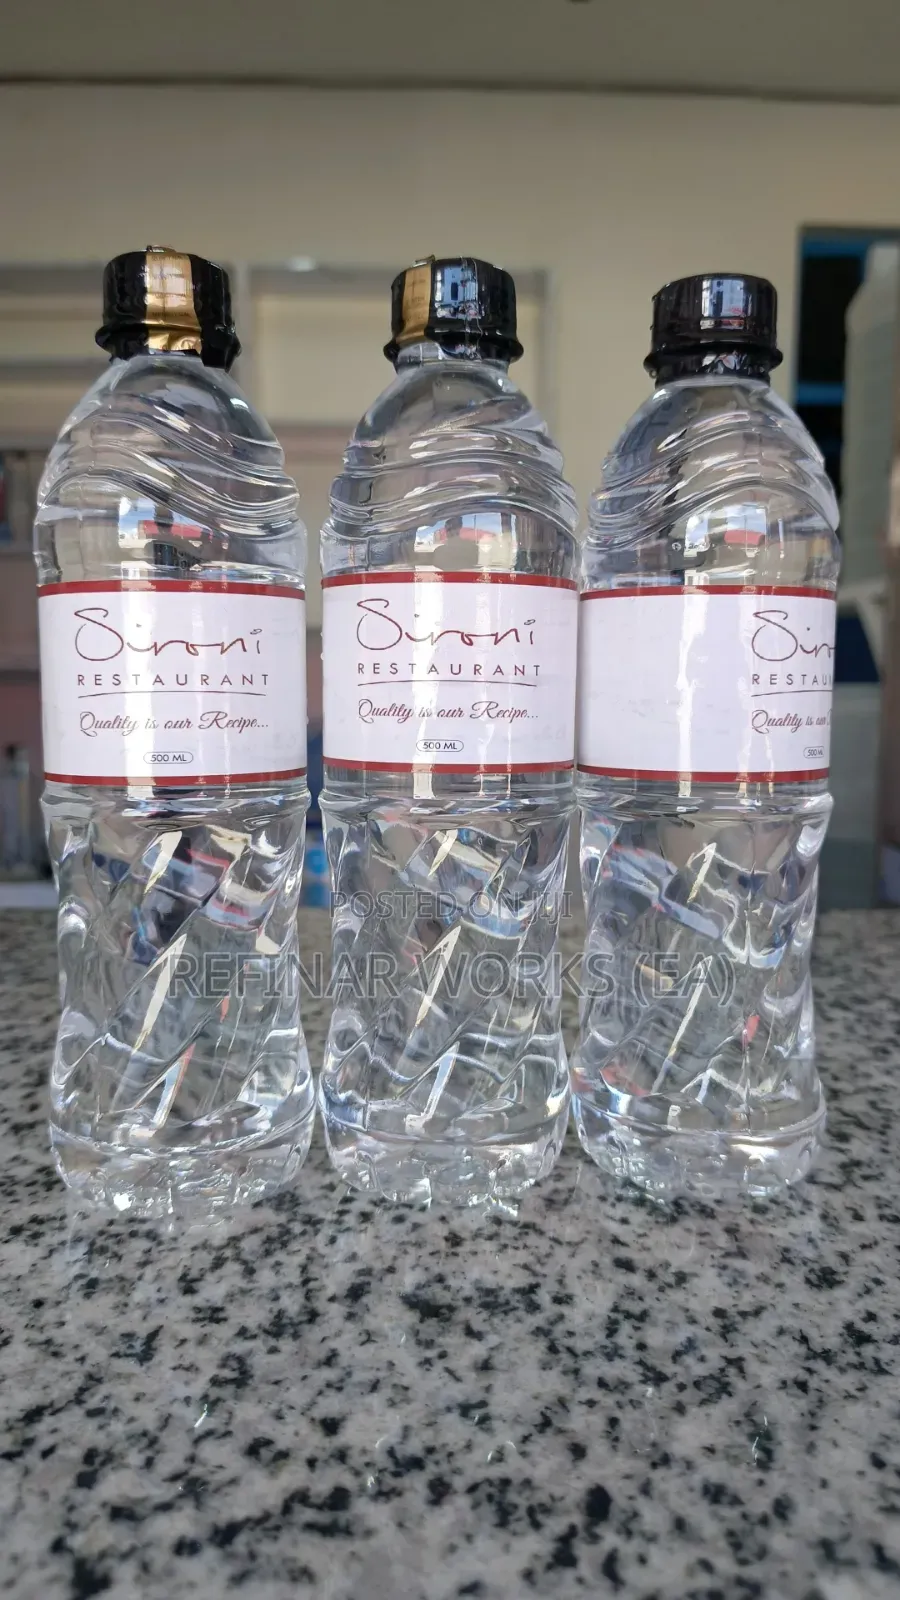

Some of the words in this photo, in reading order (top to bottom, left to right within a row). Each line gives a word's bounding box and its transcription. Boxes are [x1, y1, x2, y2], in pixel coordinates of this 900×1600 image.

[74, 607, 263, 662] Sironi
[356, 598, 536, 651] Sironi
[357, 662, 541, 677] RESTAURANT
[751, 673, 832, 686] RESTAU
[77, 673, 269, 687] RESTAURANT
[358, 698, 413, 724] Quality
[436, 706, 465, 718] our
[469, 700, 539, 723] Recipe...
[79, 711, 139, 738] Quality
[144, 716, 160, 730] is
[163, 719, 194, 730] our
[197, 710, 269, 734] Recipe...
[751, 709, 802, 735] Quality
[423, 741, 441, 750] 500
[443, 741, 458, 750] ML
[150, 753, 169, 762] 500
[172, 753, 187, 762] ML
